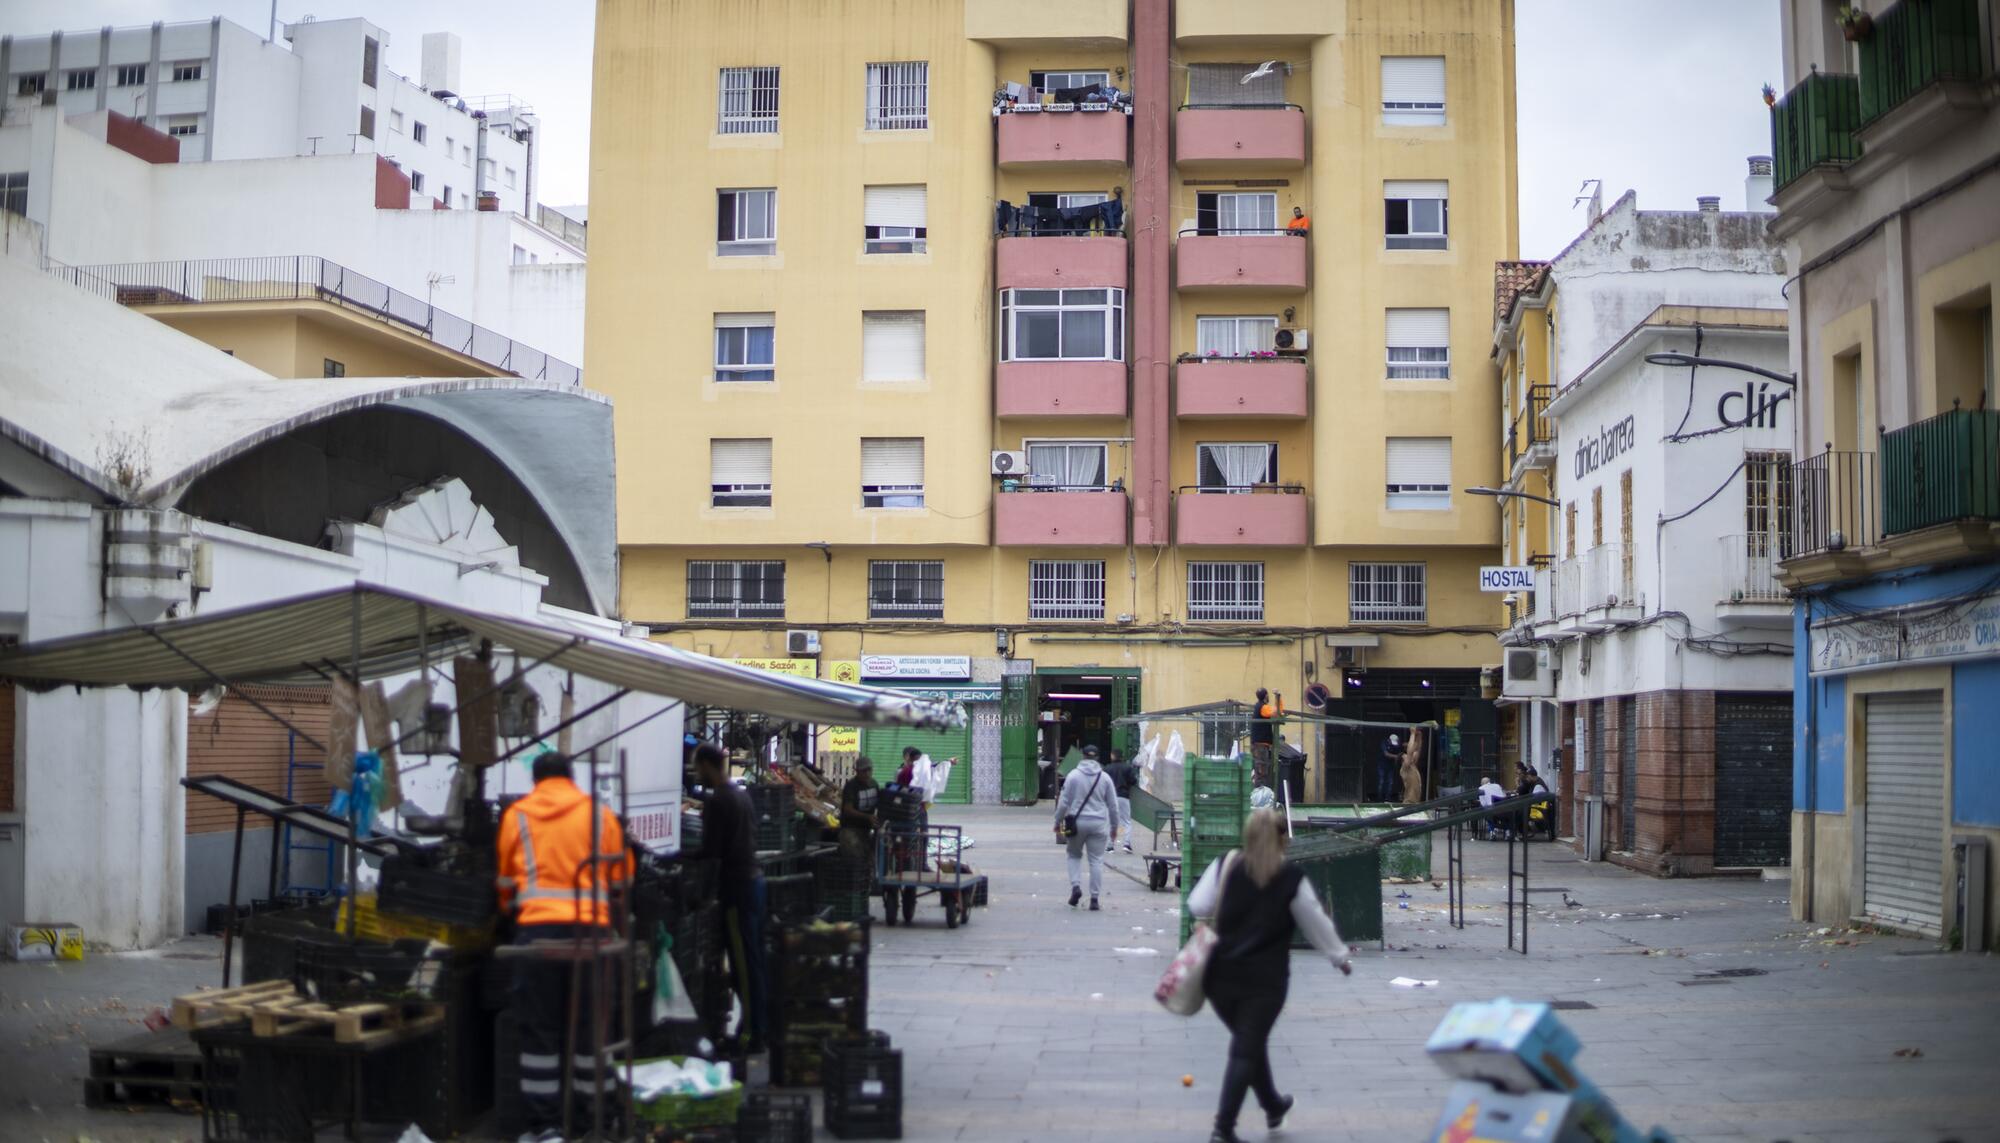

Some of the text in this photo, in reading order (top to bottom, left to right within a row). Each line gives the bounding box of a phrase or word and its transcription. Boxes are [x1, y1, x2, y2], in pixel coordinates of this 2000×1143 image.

[1574, 414, 1635, 481] clínica barrera
[1481, 570, 1533, 588] HOSTAL
[1975, 622, 2000, 647] ORIA
[769, 659, 797, 670] Sazón
